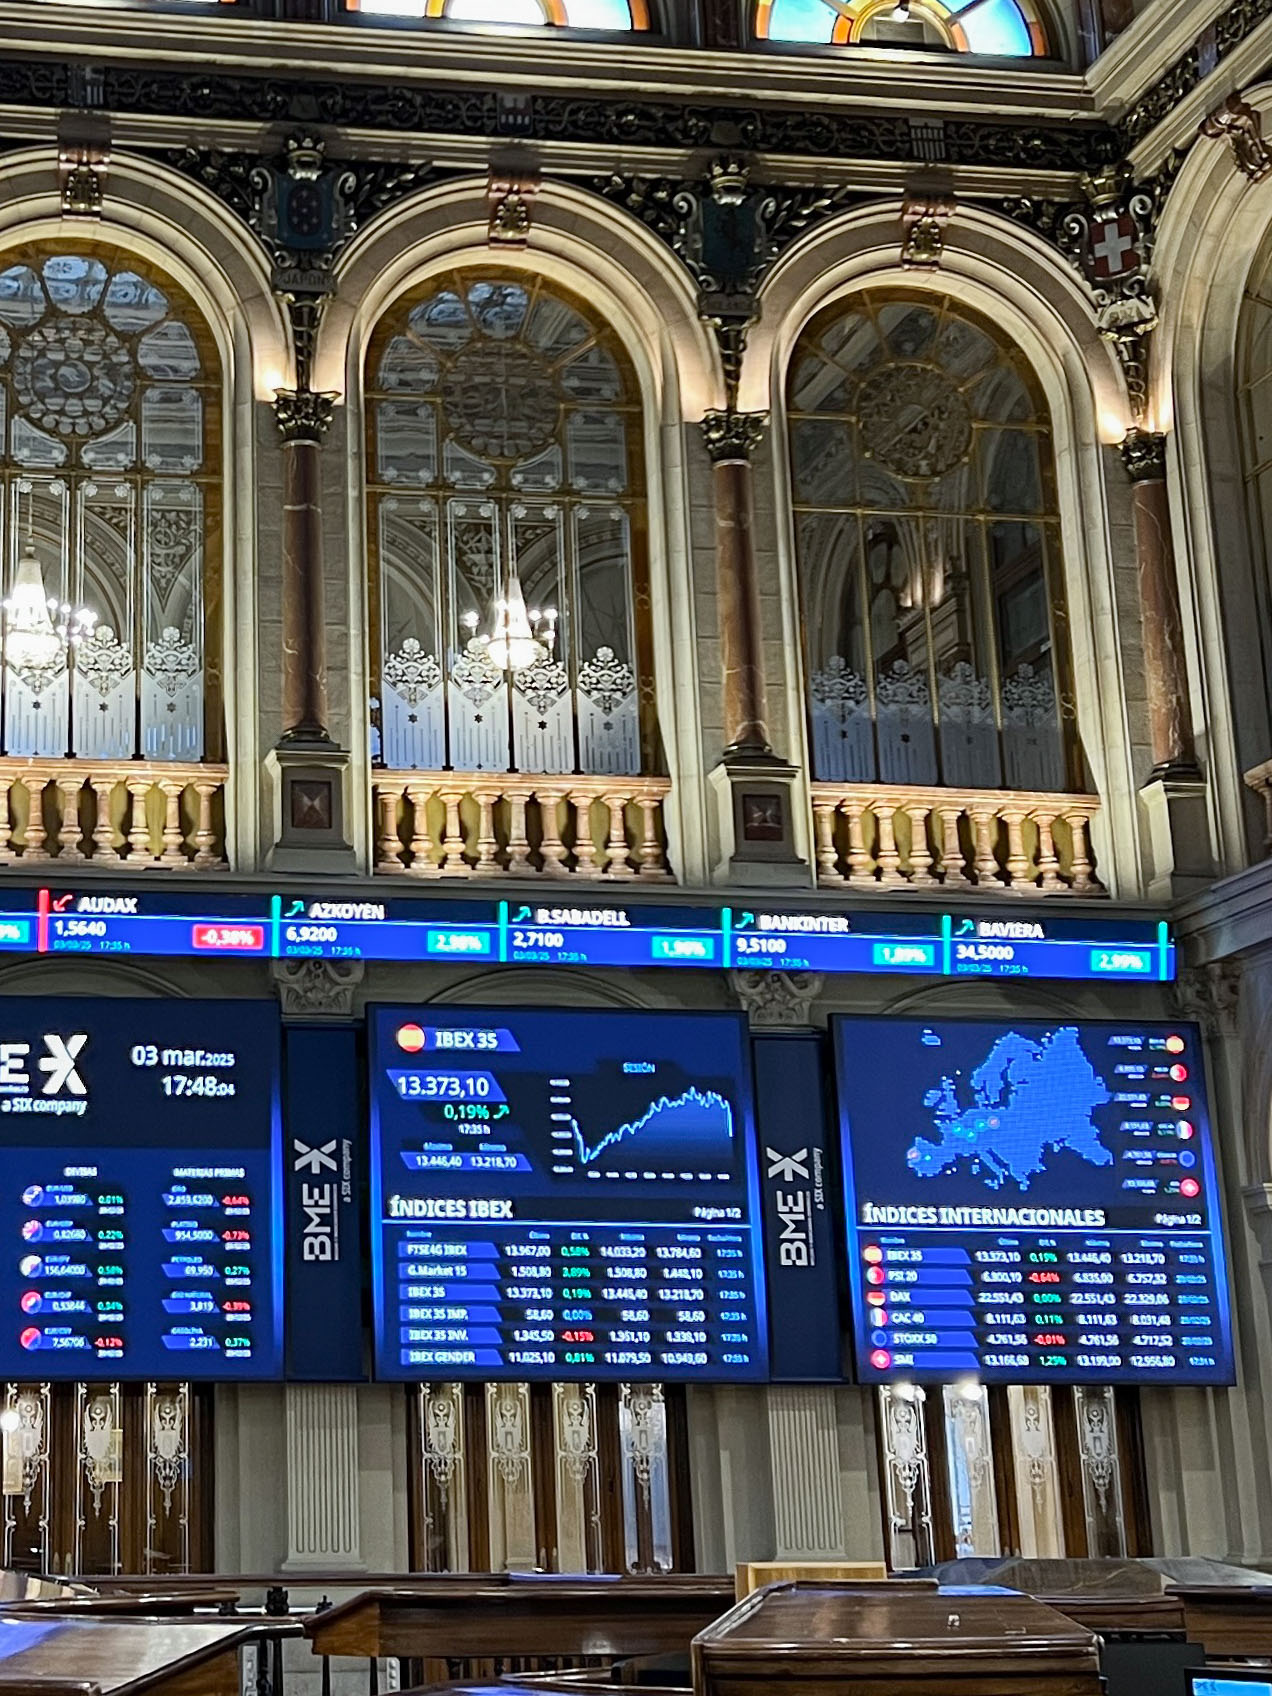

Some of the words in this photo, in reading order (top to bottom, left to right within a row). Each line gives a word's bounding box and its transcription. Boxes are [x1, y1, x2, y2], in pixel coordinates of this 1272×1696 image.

[76, 897, 137, 915] AUDAX
[306, 903, 384, 921] AZKOYEN
[55, 920, 106, 936] 1,5640
[756, 915, 848, 934] BANKINTER
[977, 922, 1044, 940] BAVIERA
[286, 927, 337, 942] 6,9200
[513, 932, 564, 948] 2,7100
[736, 938, 786, 953] 9,5100
[436, 1032, 474, 1047] IBEX
[477, 1033, 497, 1048] 35
[132, 1046, 158, 1066] 03
[398, 1077, 489, 1098] 13.373,10
[1, 1100, 11, 1112] a
[12, 1098, 34, 1112] SIX
[34, 1100, 87, 1115] company
[444, 1105, 489, 1120] 0,19%
[390, 1195, 466, 1217] ÍNDICES
[468, 1200, 513, 1218] IBEX
[694, 1207, 727, 1219] Página
[863, 1203, 938, 1224] ÍNDICES
[938, 1207, 1105, 1226] INTERNACIONALES
[302, 1184, 332, 1261] BME
[776, 1191, 808, 1266] BME
